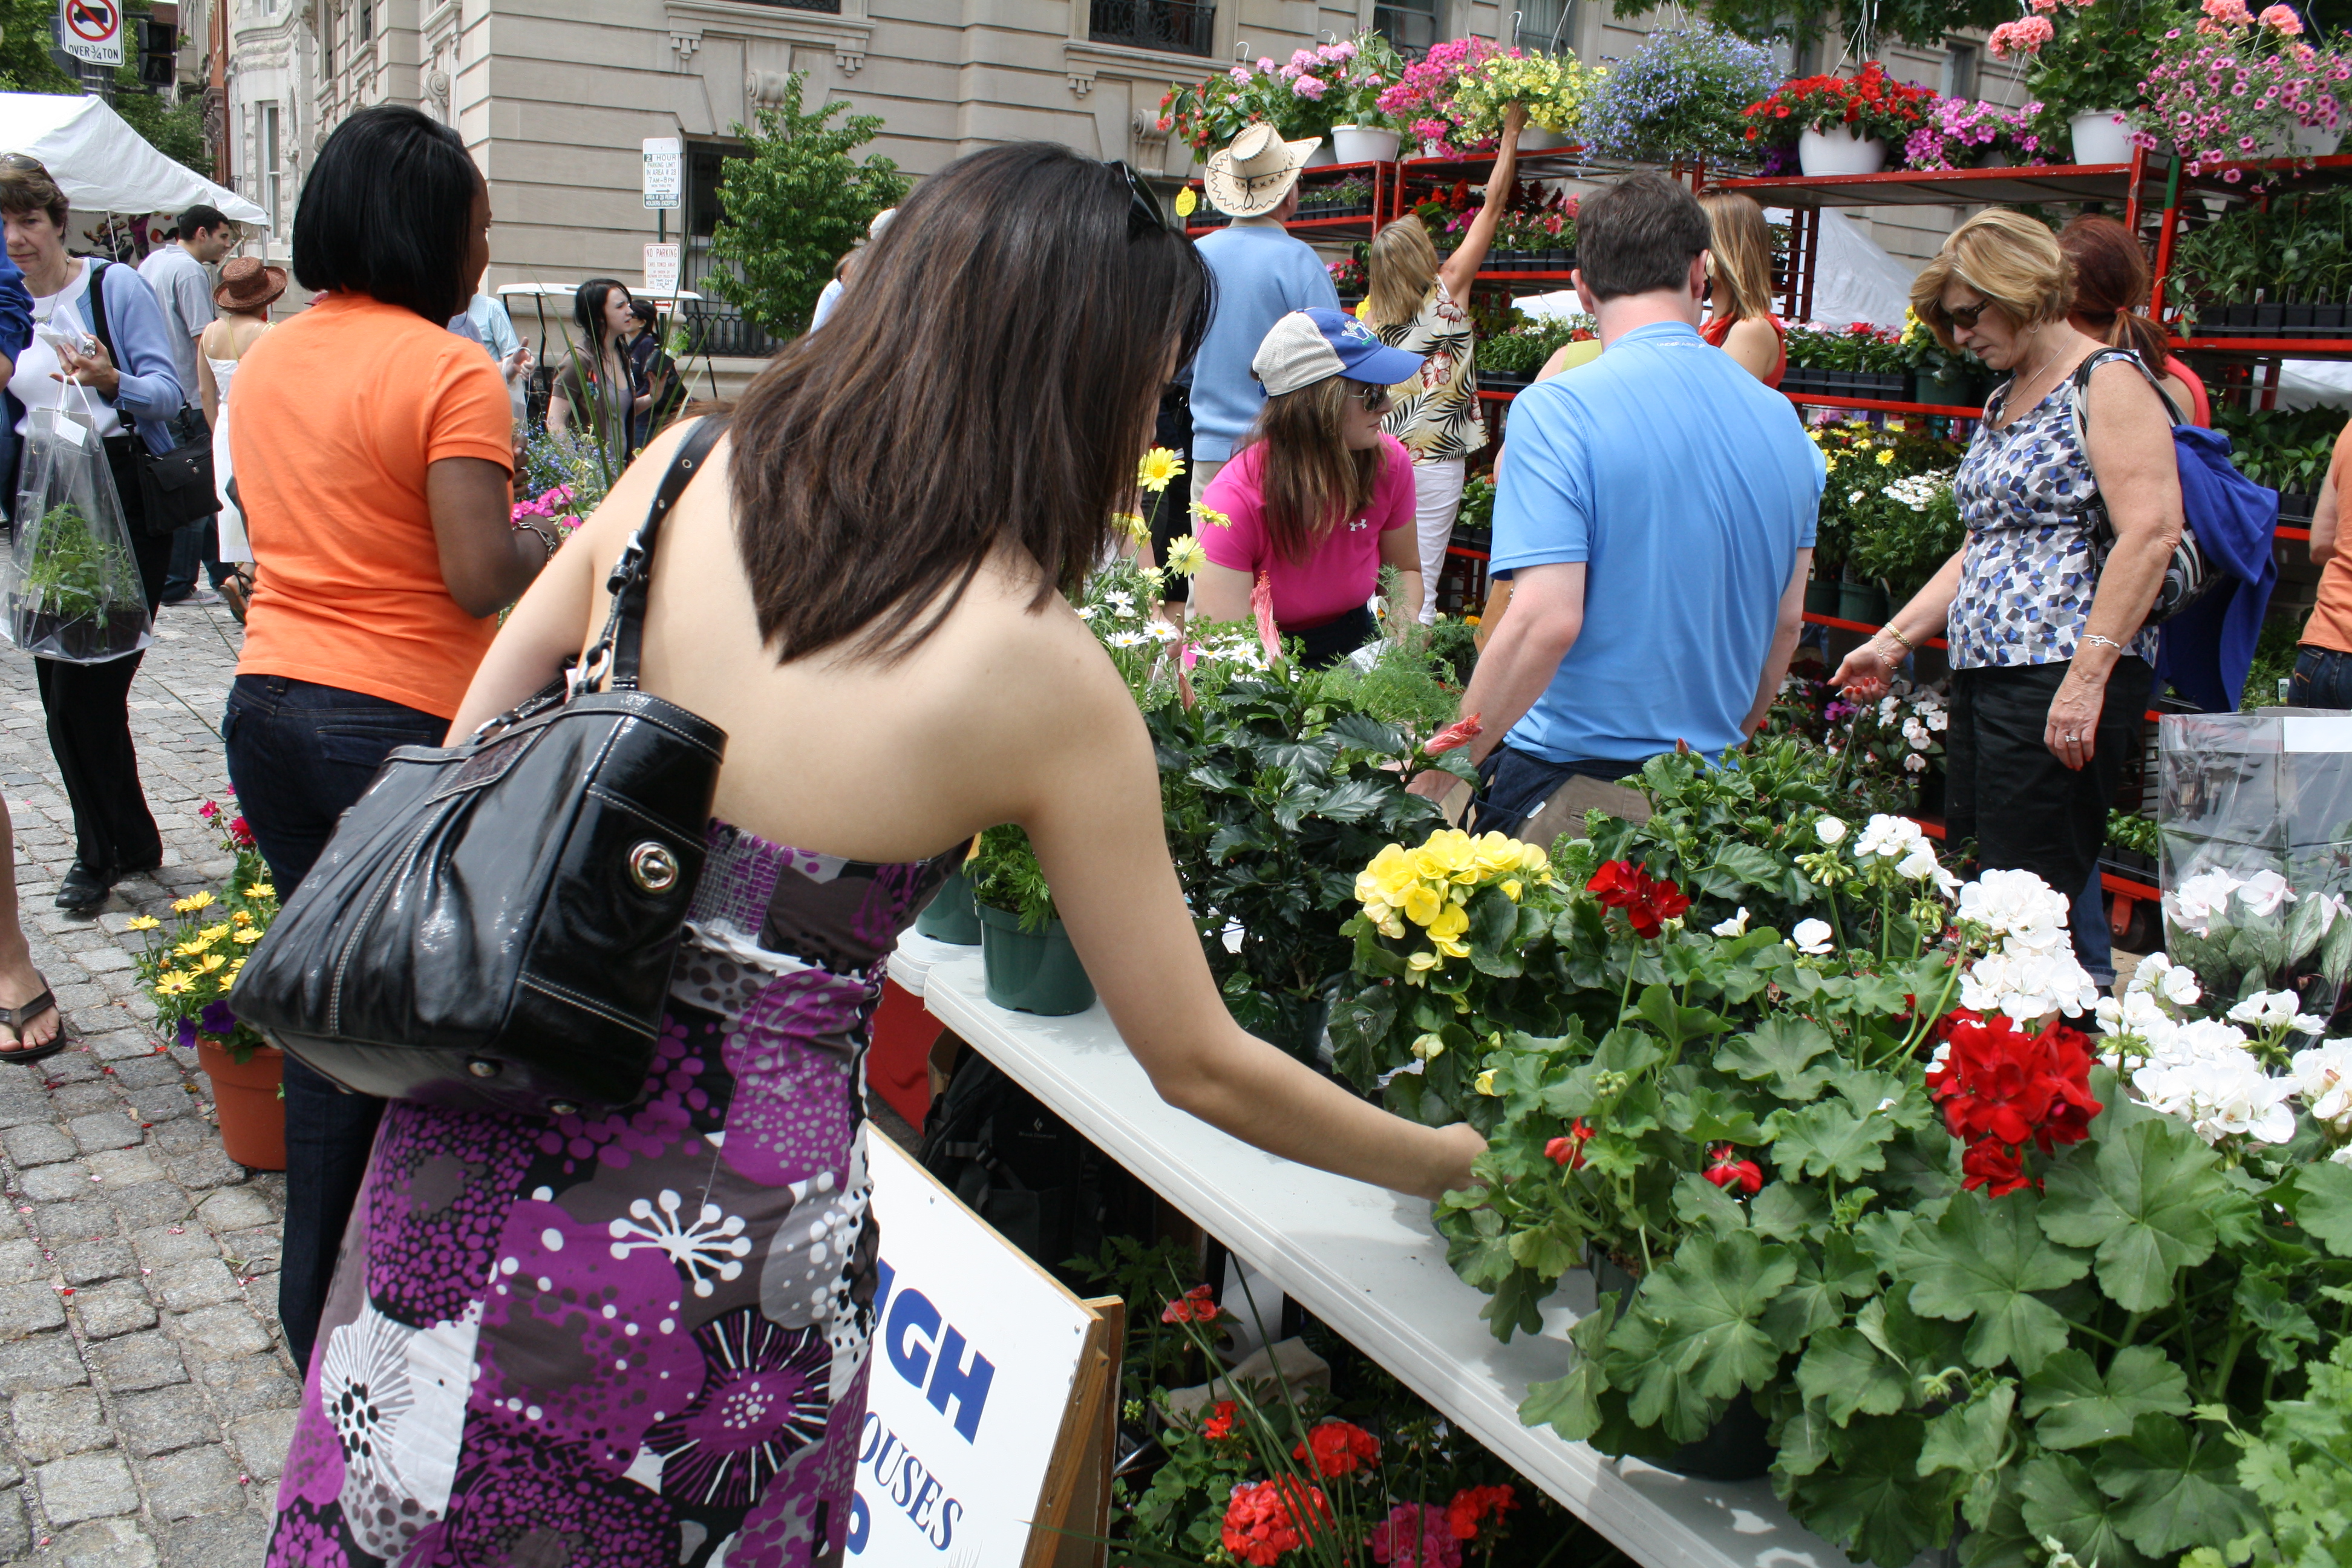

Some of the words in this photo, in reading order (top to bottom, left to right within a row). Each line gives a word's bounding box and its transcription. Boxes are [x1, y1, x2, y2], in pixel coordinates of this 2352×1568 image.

[68, 45, 90, 57] OVER
[102, 48, 119, 59] TON
[646, 248, 653, 258] NO
[656, 248, 677, 258] PARKING
